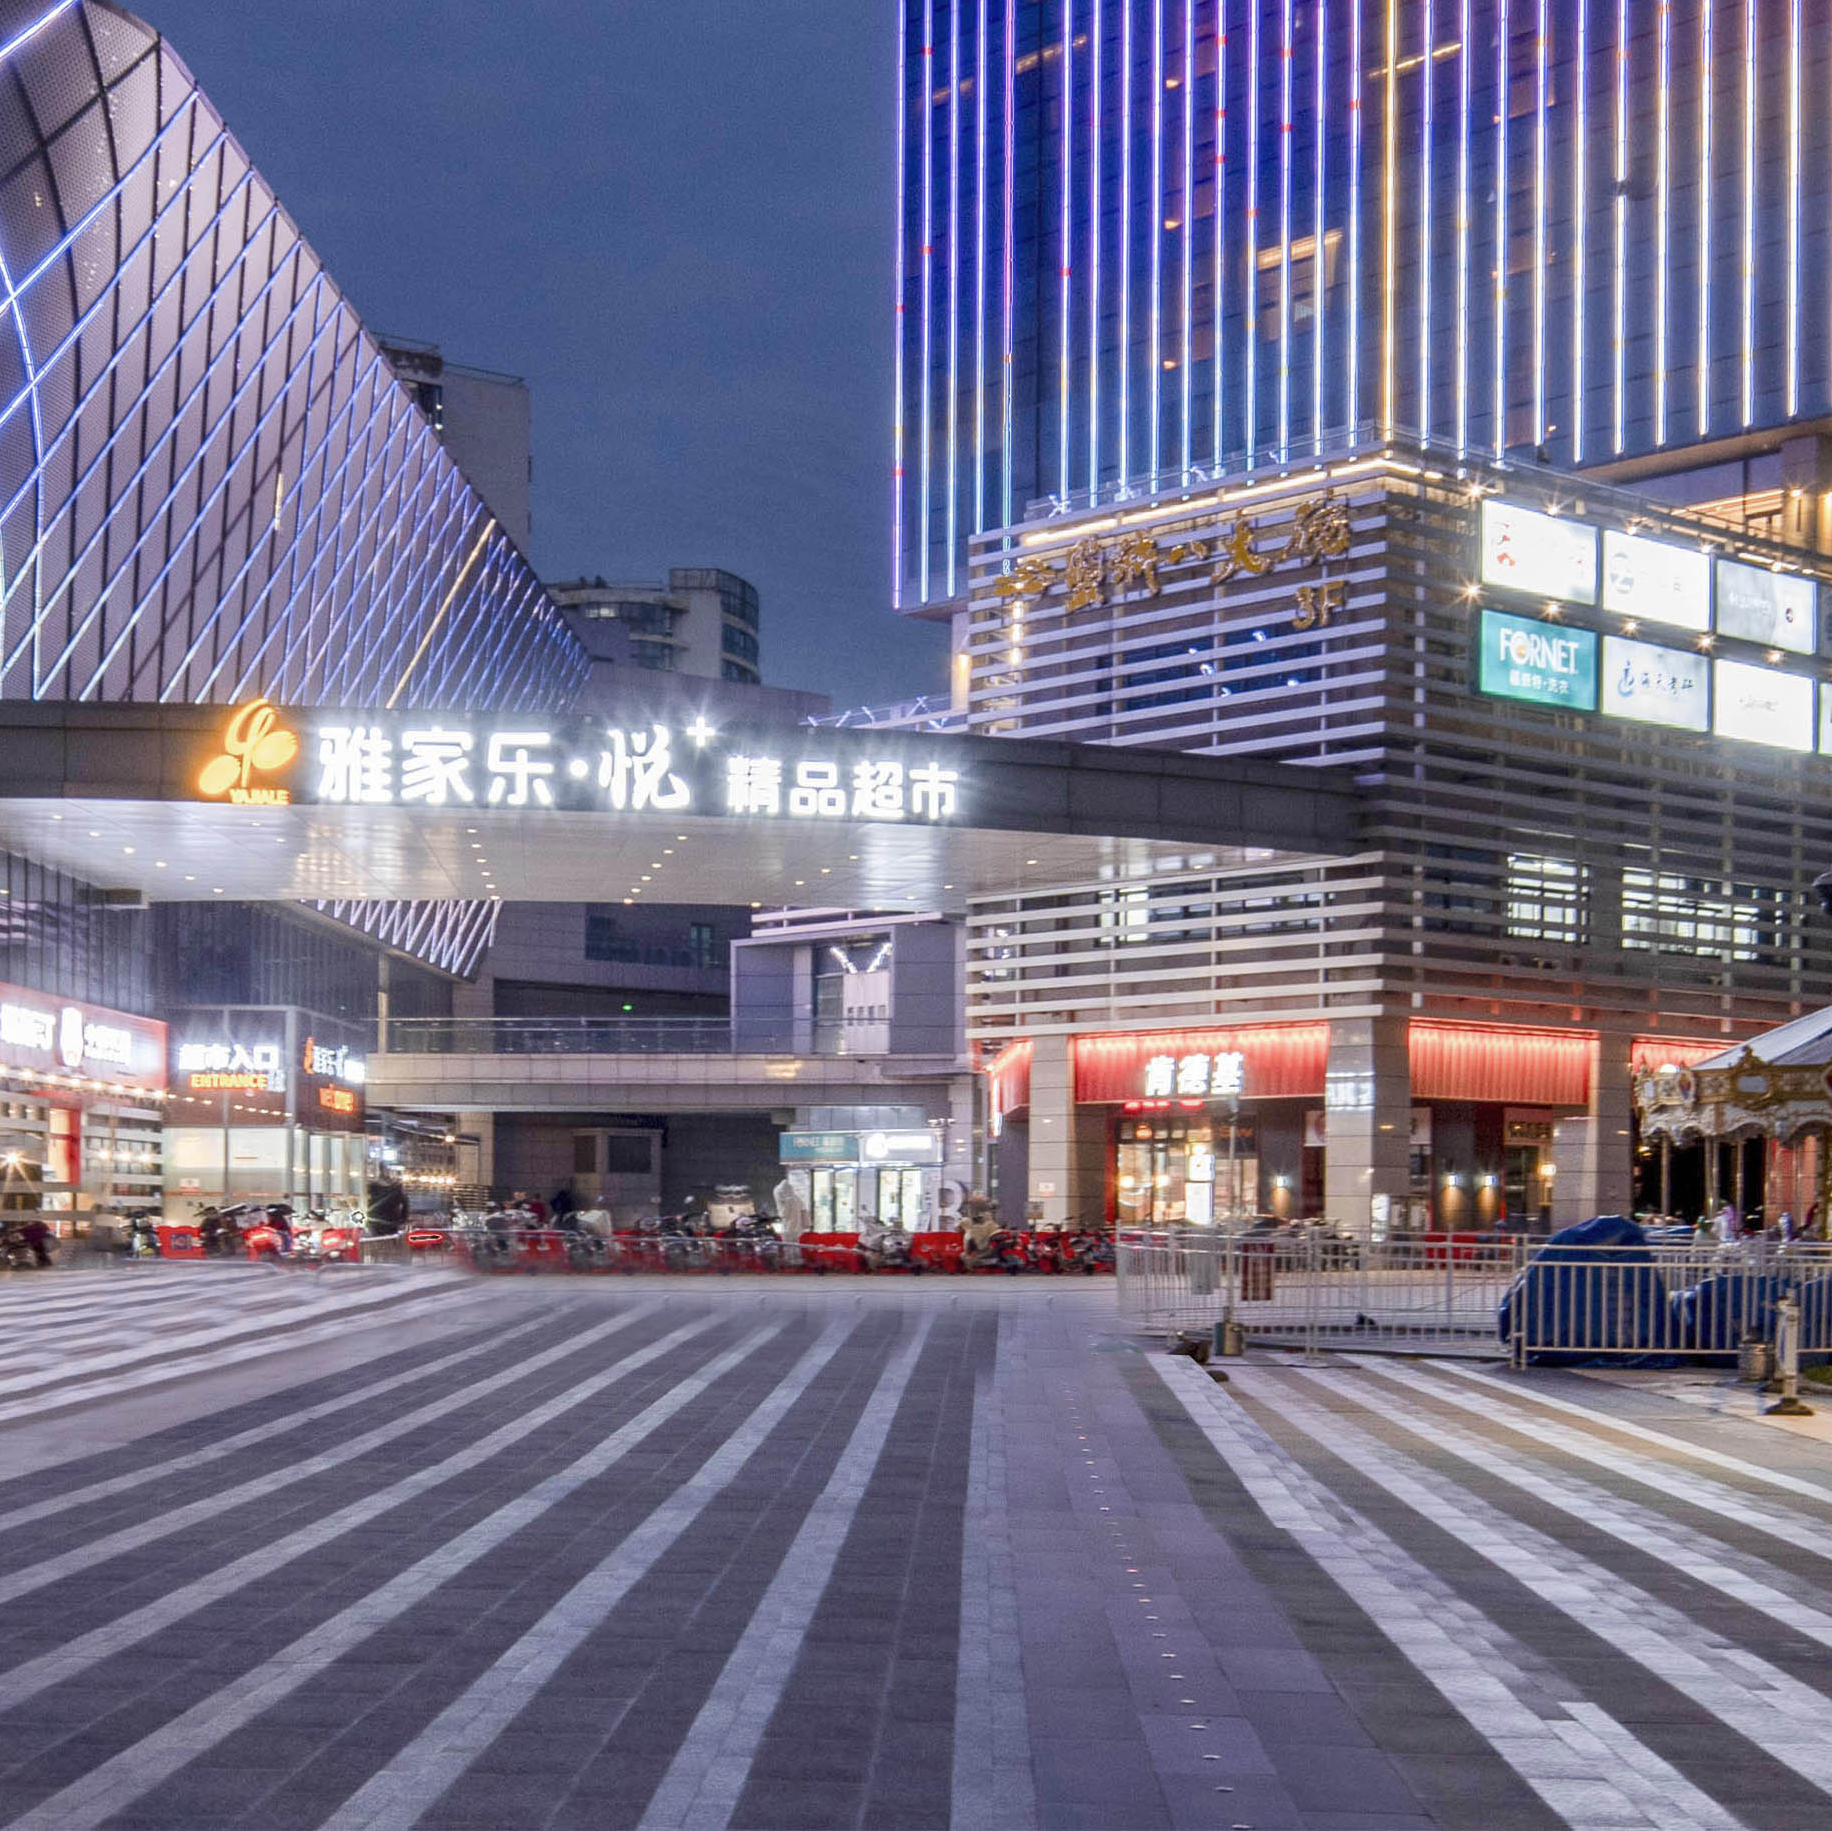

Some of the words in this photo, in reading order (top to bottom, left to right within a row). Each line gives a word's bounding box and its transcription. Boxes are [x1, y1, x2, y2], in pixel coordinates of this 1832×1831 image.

[1292, 579, 1350, 631] 3F
[1498, 627, 1580, 675] FORNET
[725, 754, 960, 821] 精品超市
[190, 1073, 268, 1091] ENTRANCE
[1144, 1051, 1244, 1098] 肯德基
